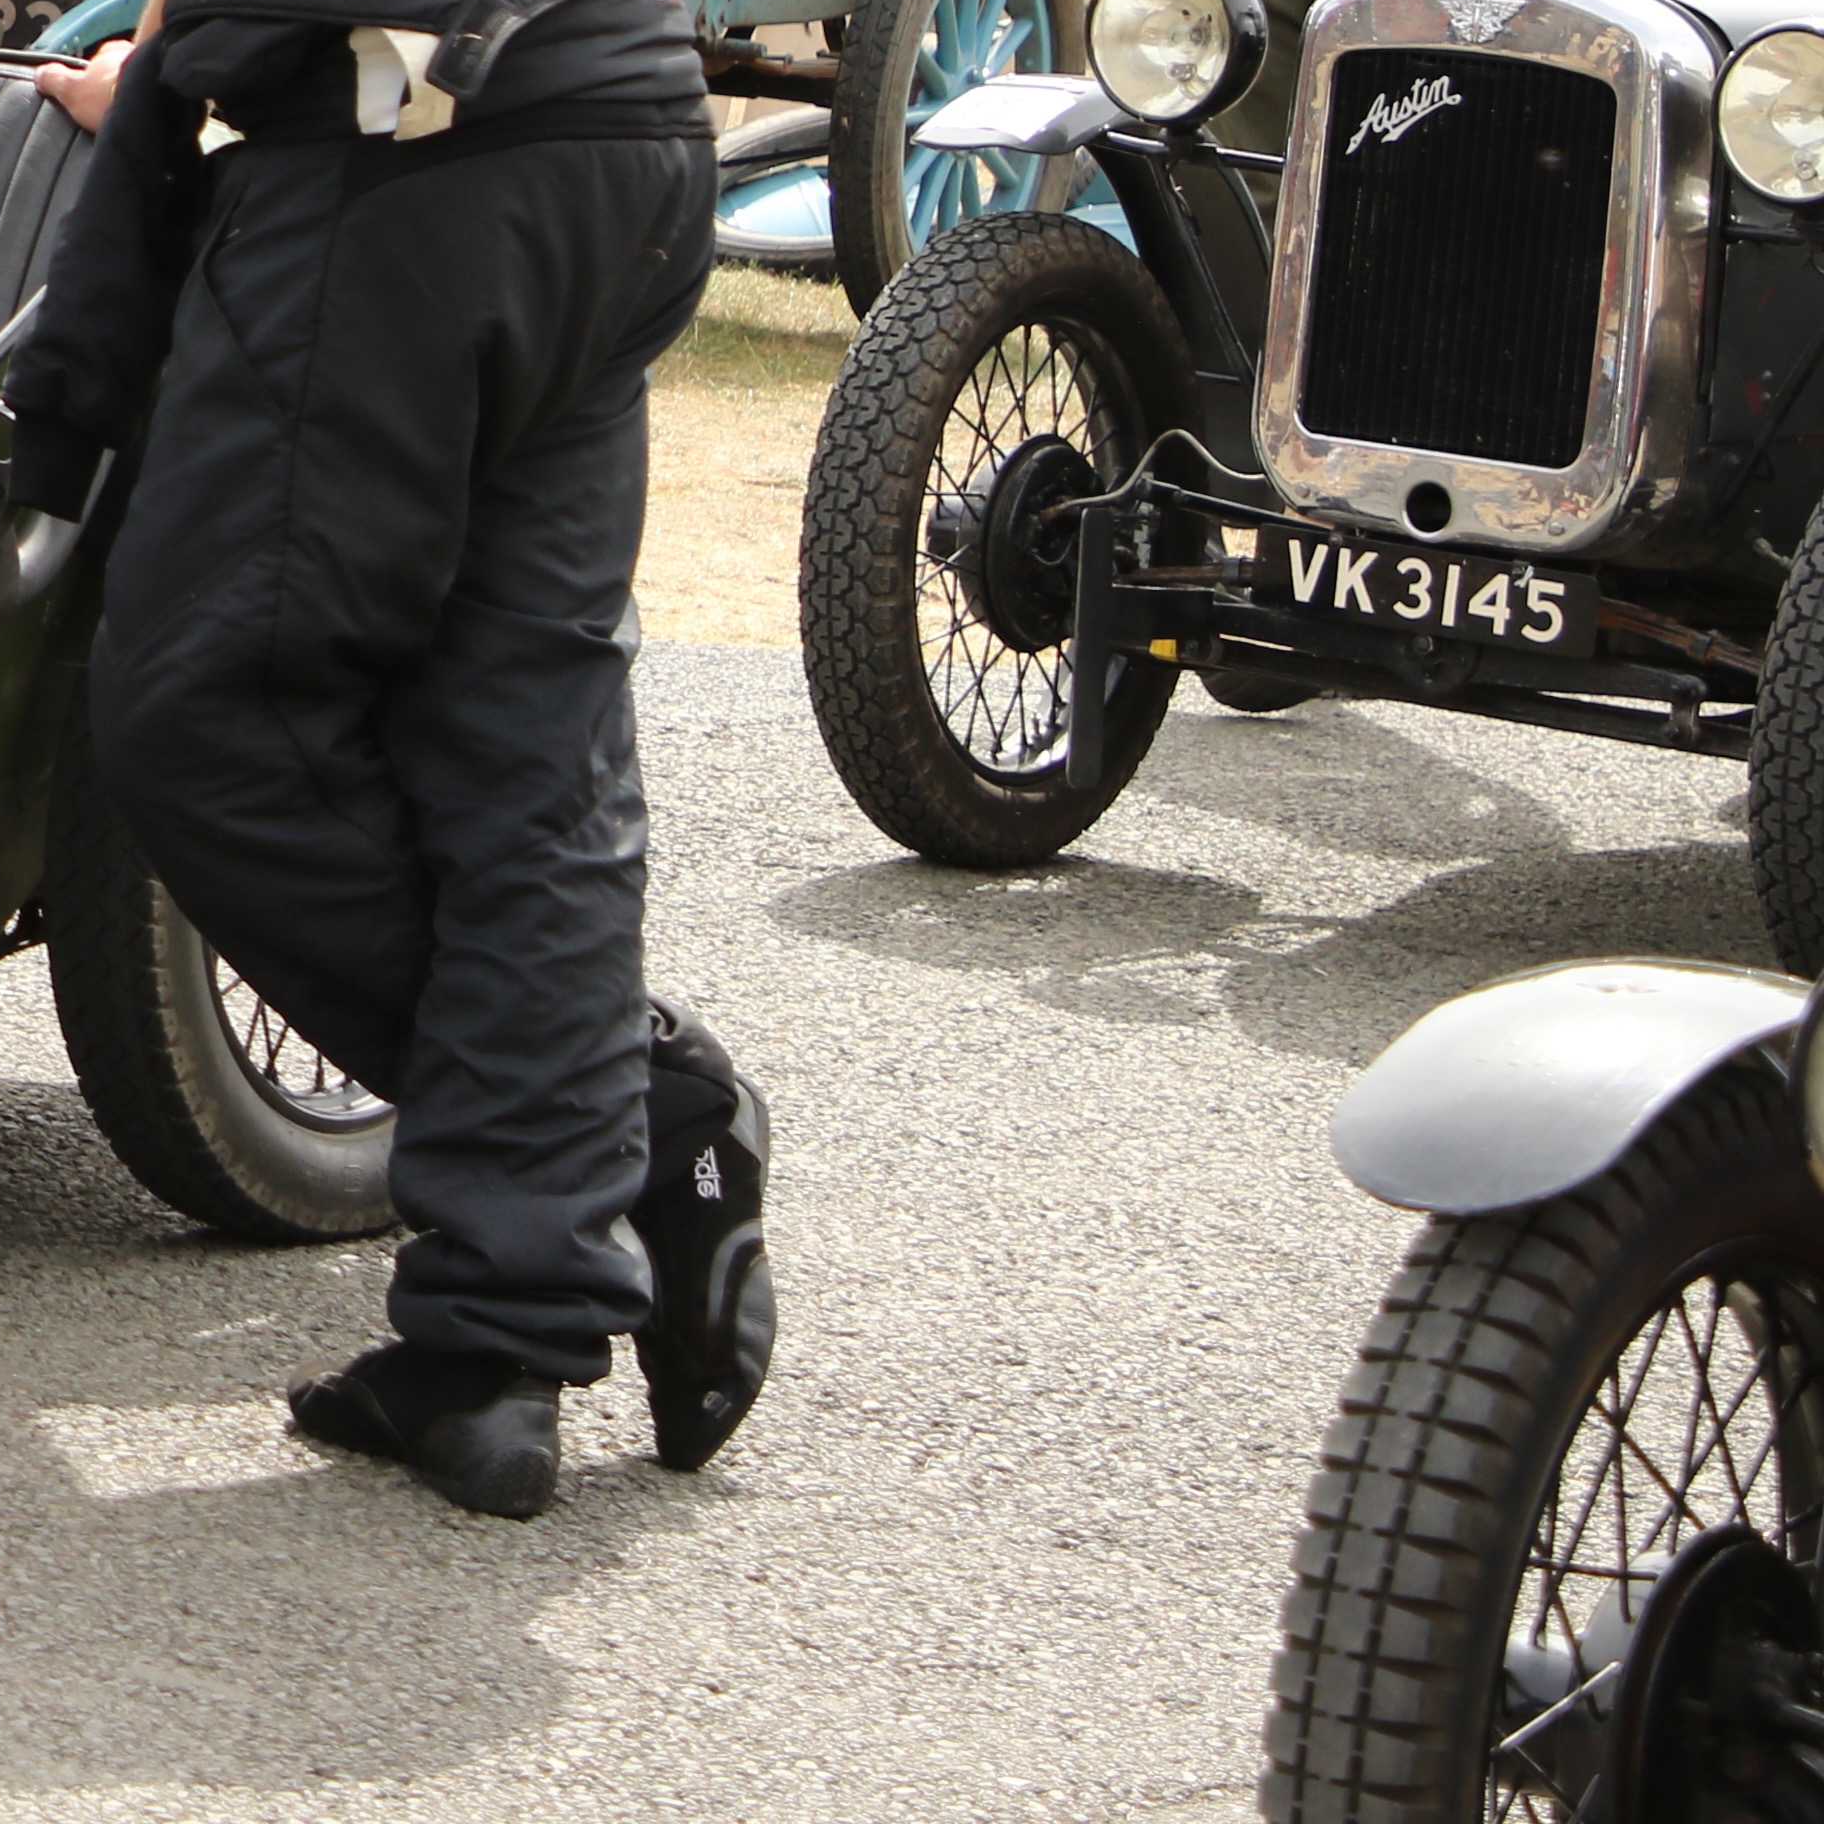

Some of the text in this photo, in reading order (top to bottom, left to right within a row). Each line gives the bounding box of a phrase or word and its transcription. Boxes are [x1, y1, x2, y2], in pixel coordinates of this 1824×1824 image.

[1346, 75, 1462, 155] Austin
[1288, 538, 1566, 643] VK 3145
